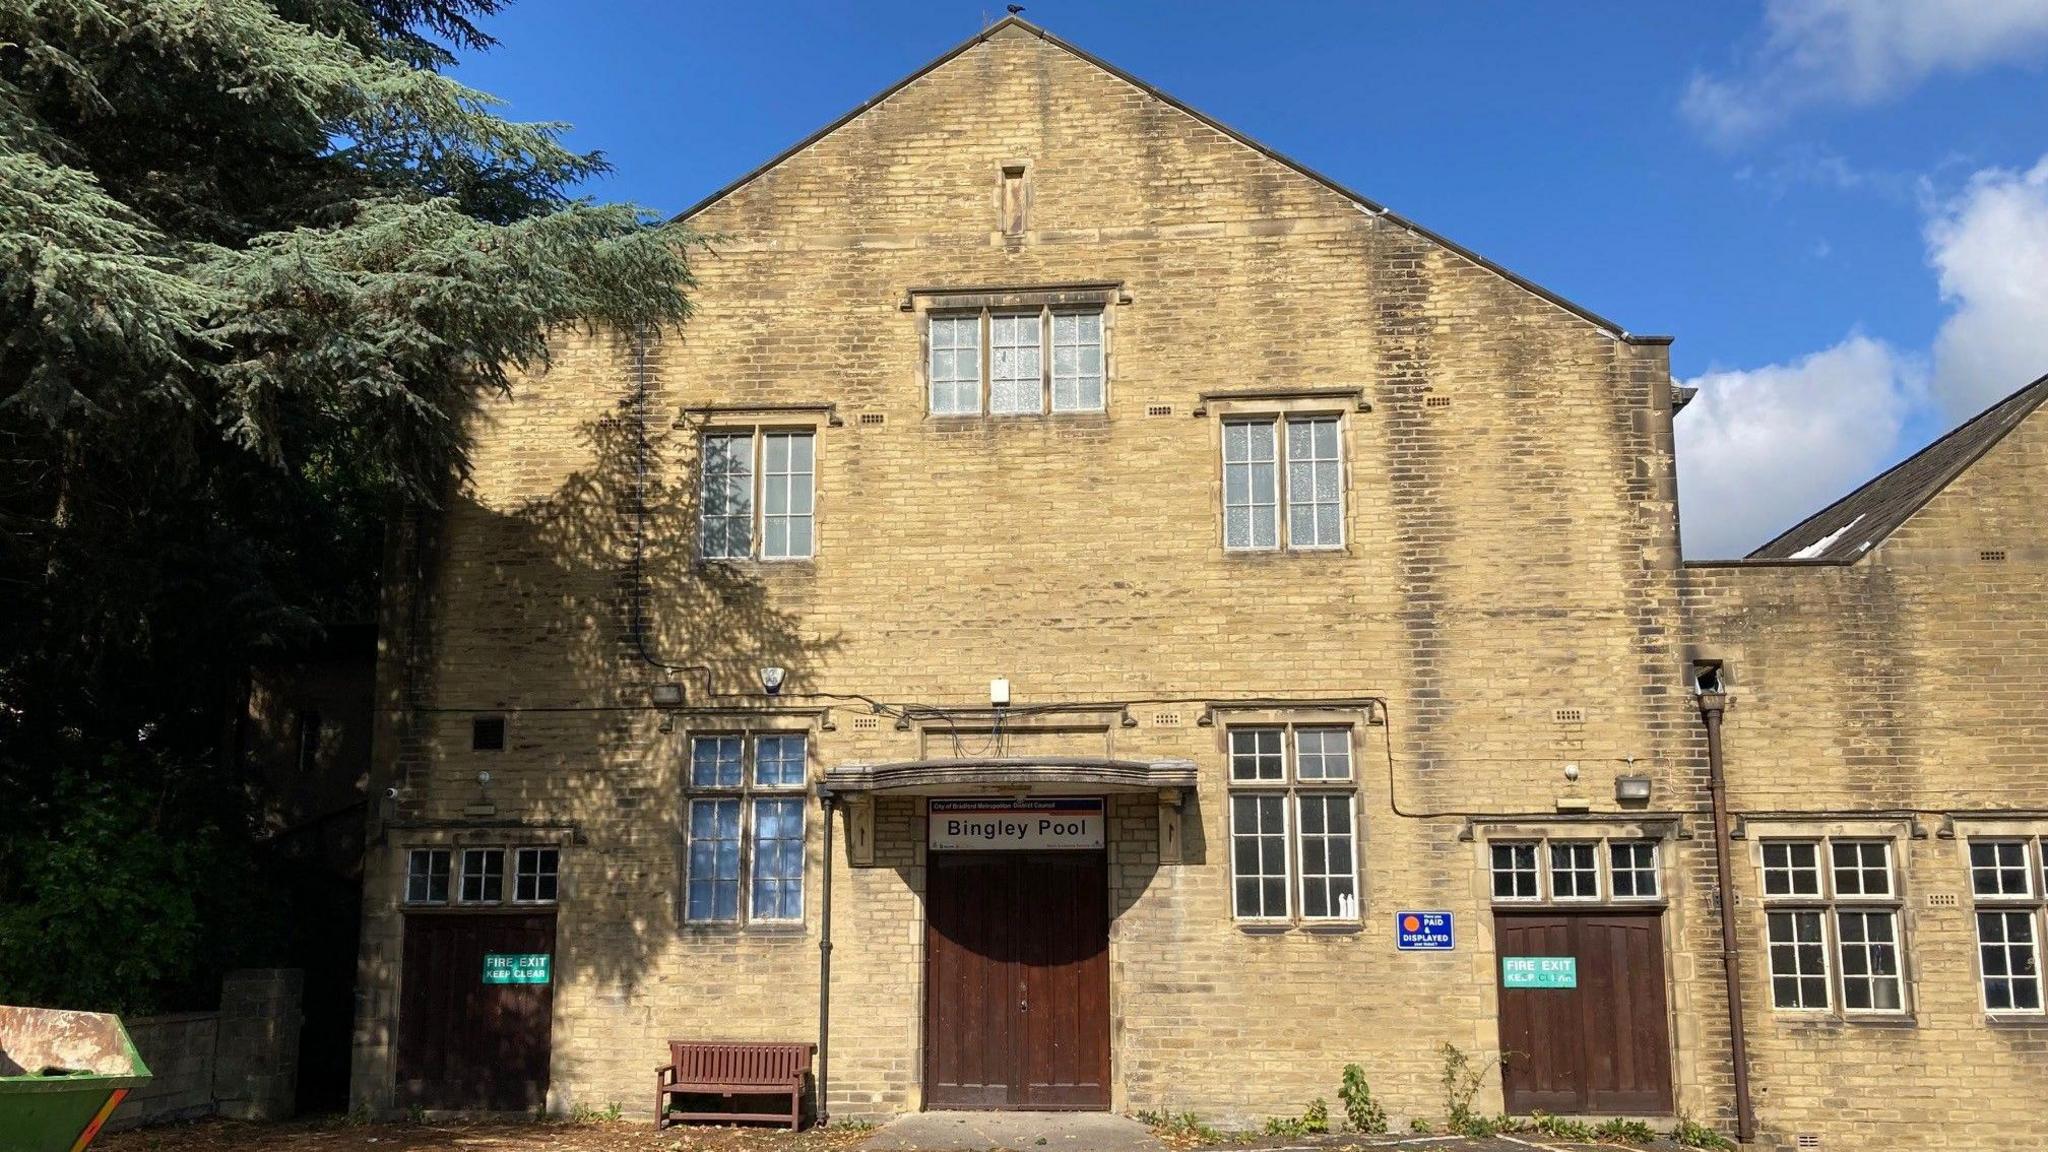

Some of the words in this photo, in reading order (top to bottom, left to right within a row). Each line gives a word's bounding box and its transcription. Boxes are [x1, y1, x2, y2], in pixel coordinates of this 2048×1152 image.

[948, 820, 1028, 839] Bingley
[1038, 819, 1086, 836] Pool
[487, 957, 513, 967] FIRE
[520, 957, 546, 967] EXIT
[1506, 960, 1535, 971] FIRE
[1541, 960, 1571, 971] EXIT
[486, 969, 511, 978] KEEP
[513, 969, 545, 978] CLEAR
[1507, 973, 1535, 982] KEEP
